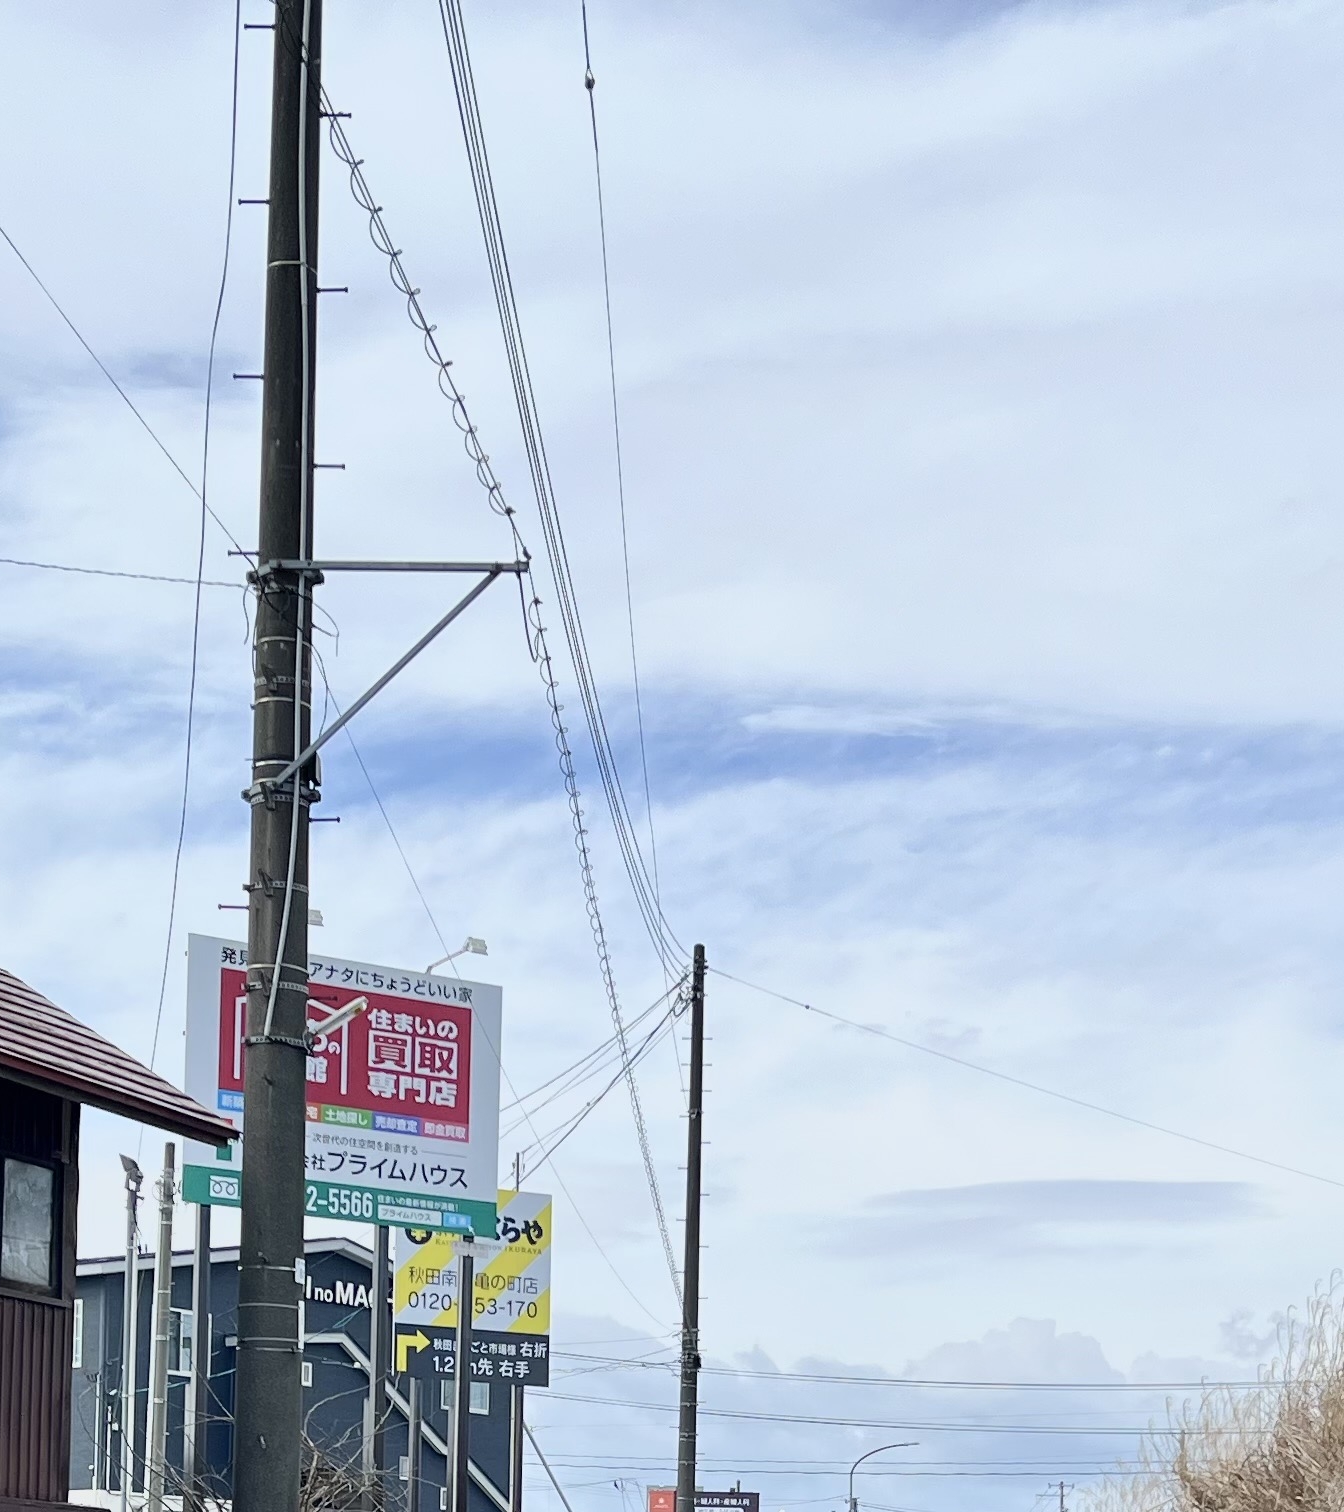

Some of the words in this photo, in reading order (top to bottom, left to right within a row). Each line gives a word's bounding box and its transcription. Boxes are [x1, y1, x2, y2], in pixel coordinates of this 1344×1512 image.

[309, 962, 472, 1003] アナタにちょうどいい家
[367, 1008, 458, 1040] 住まいの
[367, 1029, 458, 1079] 買取
[367, 1070, 458, 1109] 専門店
[306, 1185, 374, 1219] 2-5566
[381, 1208, 432, 1223] プライムハウス
[519, 1341, 547, 1359] 右折
[498, 1359, 531, 1379] 右手
